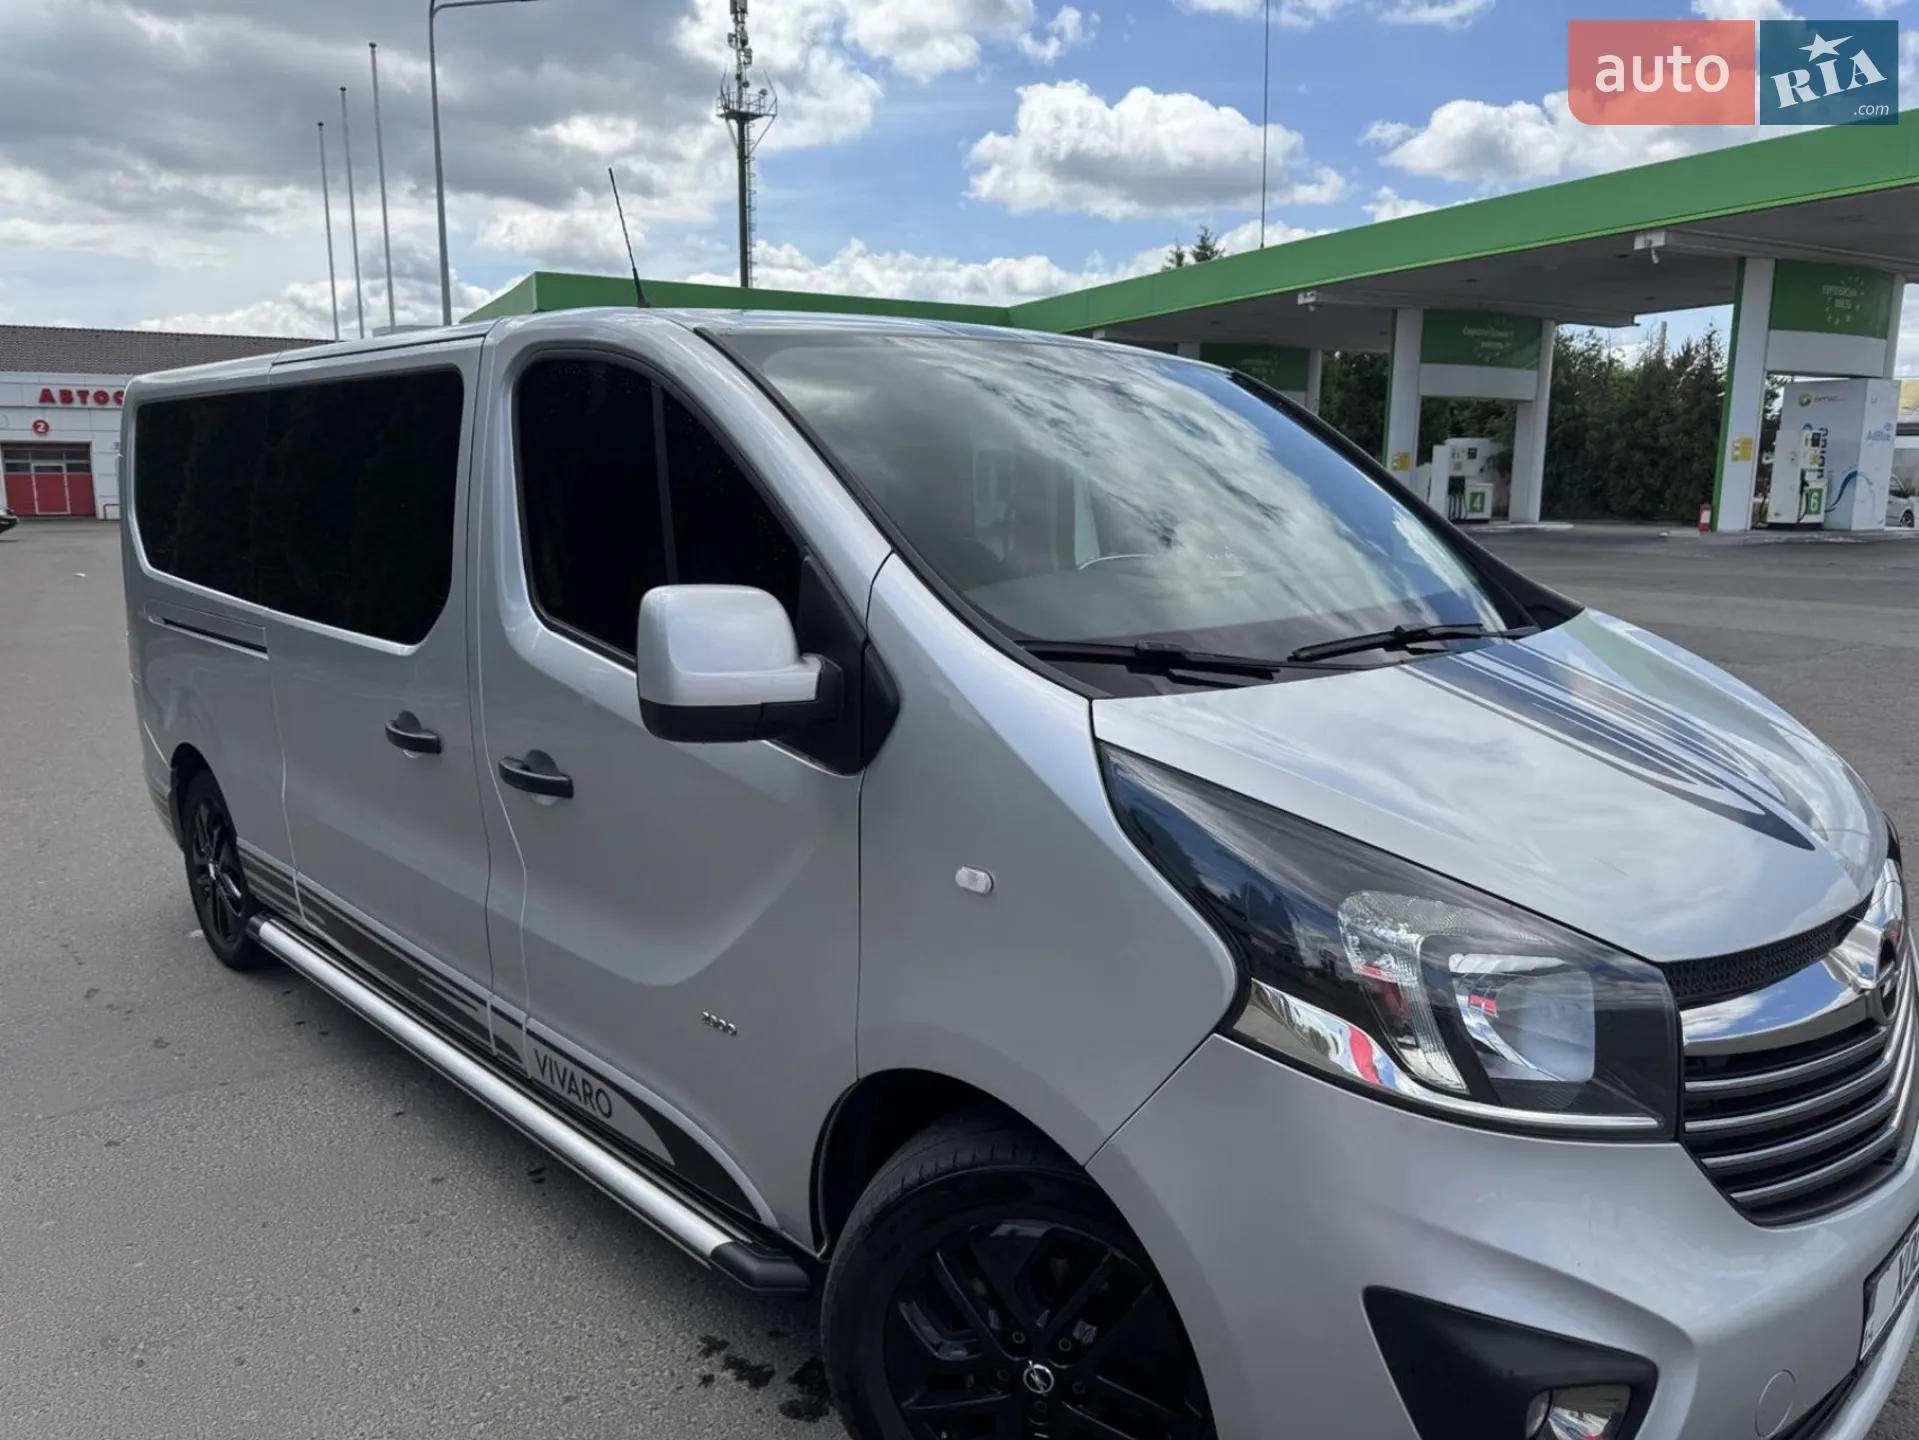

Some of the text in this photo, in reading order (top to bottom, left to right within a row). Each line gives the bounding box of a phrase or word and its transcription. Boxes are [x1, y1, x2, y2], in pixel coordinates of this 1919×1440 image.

[37, 422, 46, 432] 2
[1472, 494, 1482, 510] 4
[1810, 492, 1819, 512] 6
[534, 1048, 612, 1118] VIVARO
